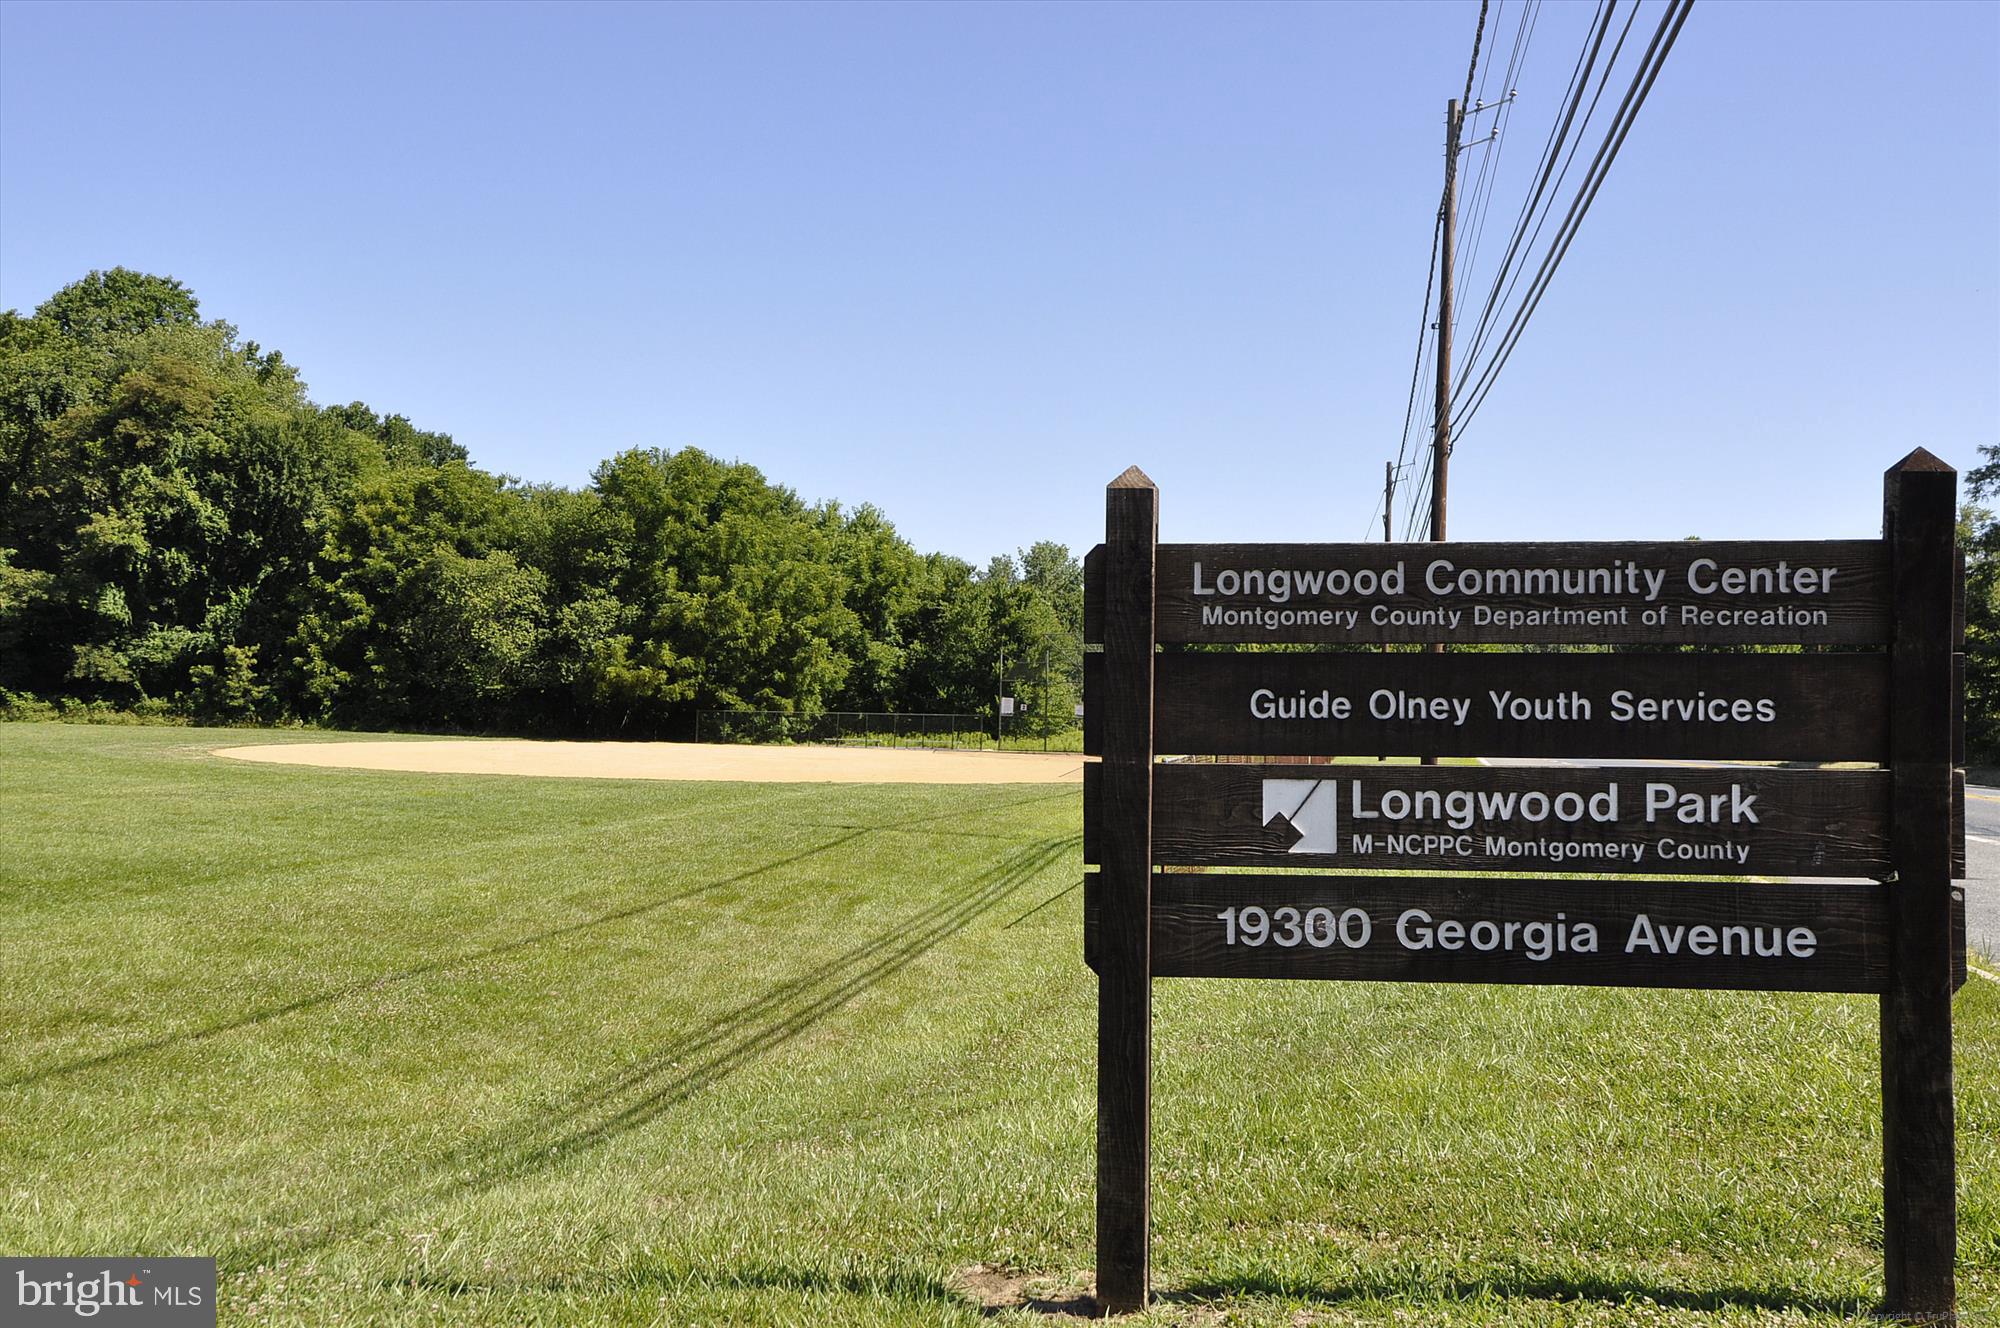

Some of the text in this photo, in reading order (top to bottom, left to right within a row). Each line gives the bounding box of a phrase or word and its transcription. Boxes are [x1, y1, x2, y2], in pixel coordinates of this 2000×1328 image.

[1193, 558, 1838, 603] Longwood Community Center
[1202, 605, 1829, 630] Montgomery County Department of Recreation
[1250, 688, 1776, 727] Guide Olney Youth Services
[1352, 779, 1760, 831] Longwood Park
[1352, 834, 1750, 865] M-NCPPC Montgomery County
[1395, 908, 1599, 961] Georgia
[1624, 914, 1818, 958] Avenue
